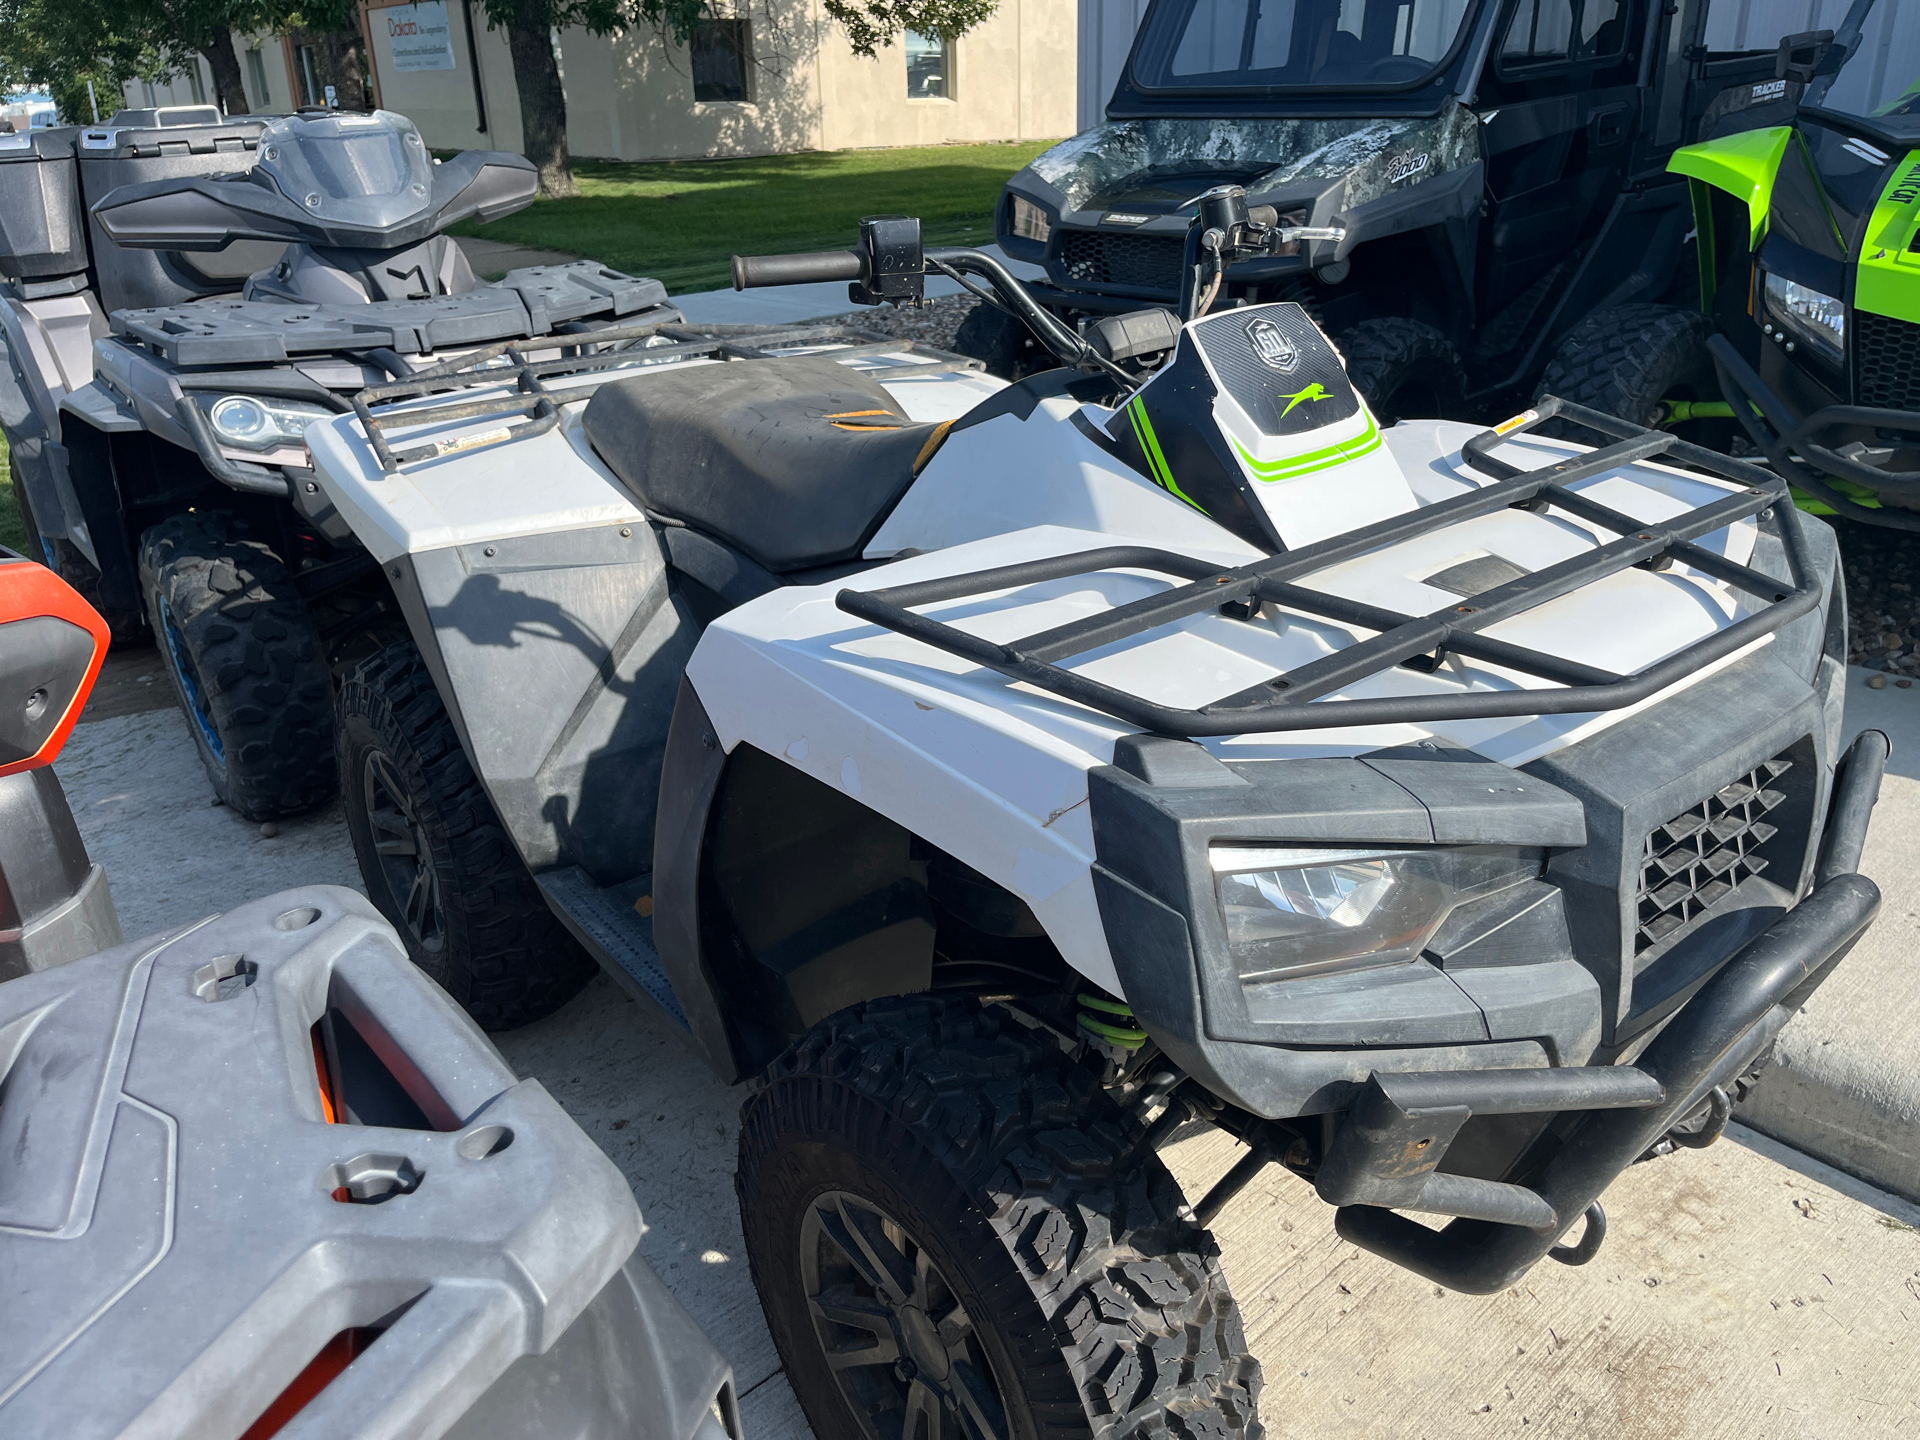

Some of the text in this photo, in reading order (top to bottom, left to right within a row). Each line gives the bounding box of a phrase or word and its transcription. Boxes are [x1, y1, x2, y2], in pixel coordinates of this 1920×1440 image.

[388, 17, 418, 37] Dakota
[1752, 79, 1786, 98] TRACKER
[1887, 189, 1918, 205] CAT
